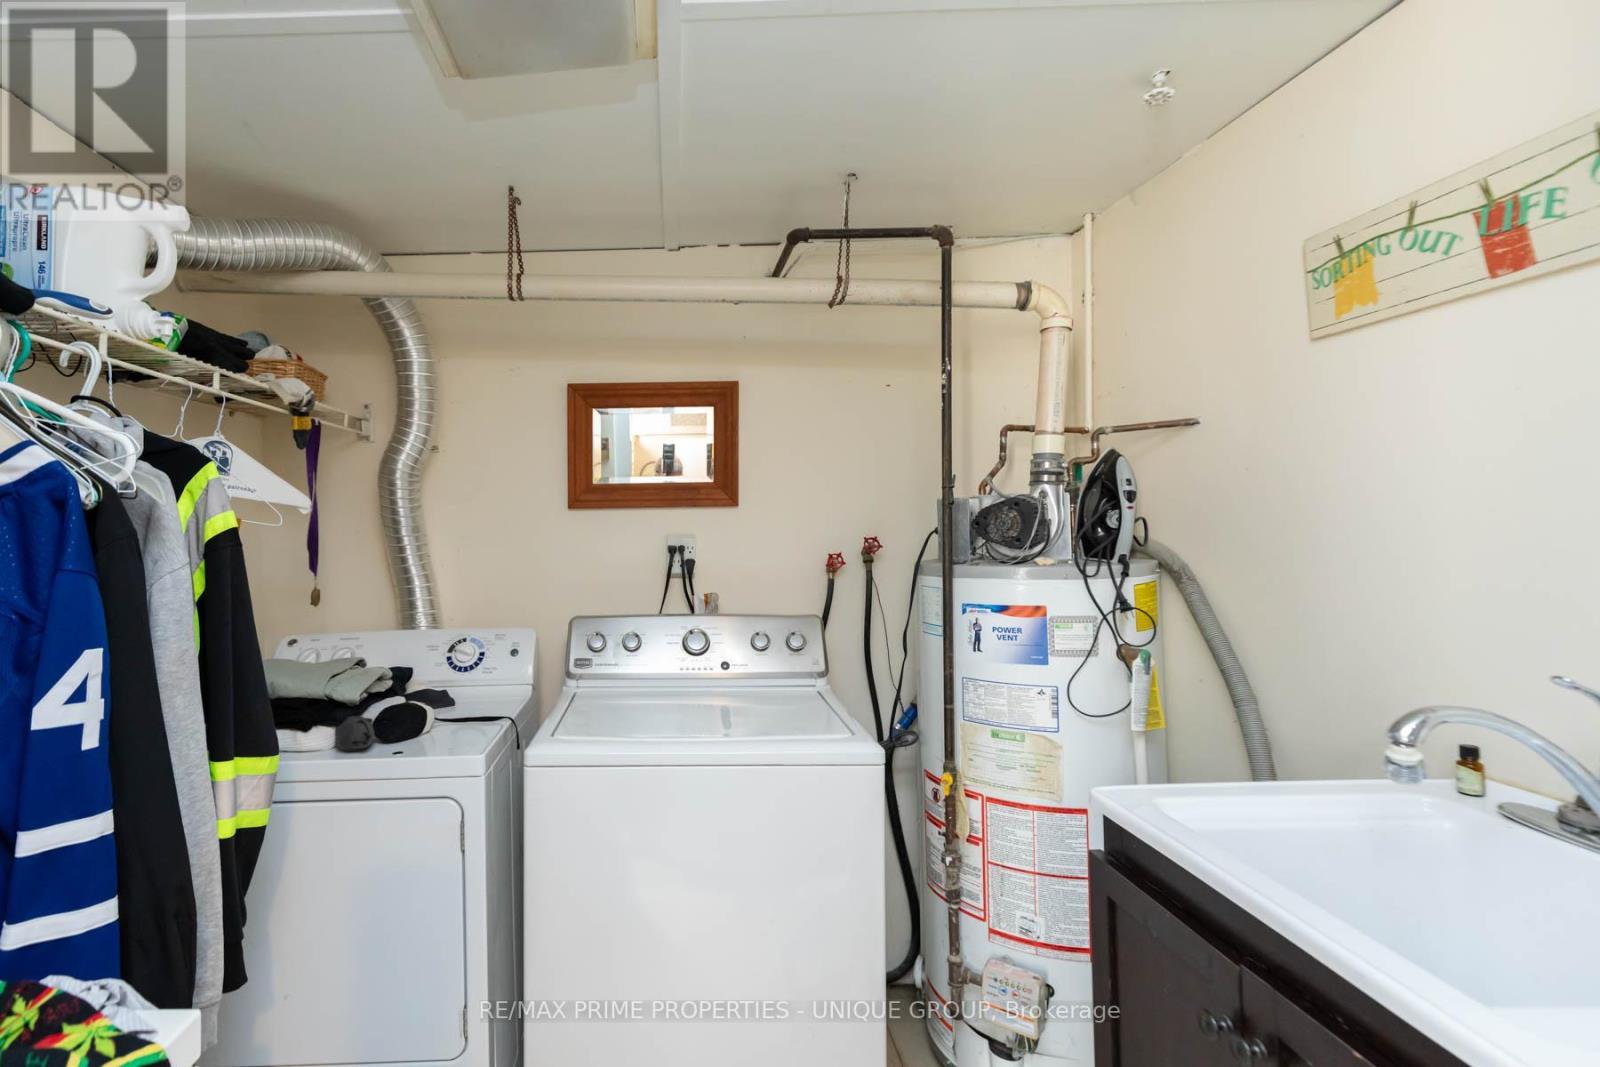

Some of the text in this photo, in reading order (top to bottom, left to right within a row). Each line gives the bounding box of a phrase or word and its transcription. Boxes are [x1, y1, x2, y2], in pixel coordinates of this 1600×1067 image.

[1311, 186, 1569, 290] SORTING OUT LIFE
[992, 626, 1023, 634] POWER
[30, 647, 105, 752] 4
